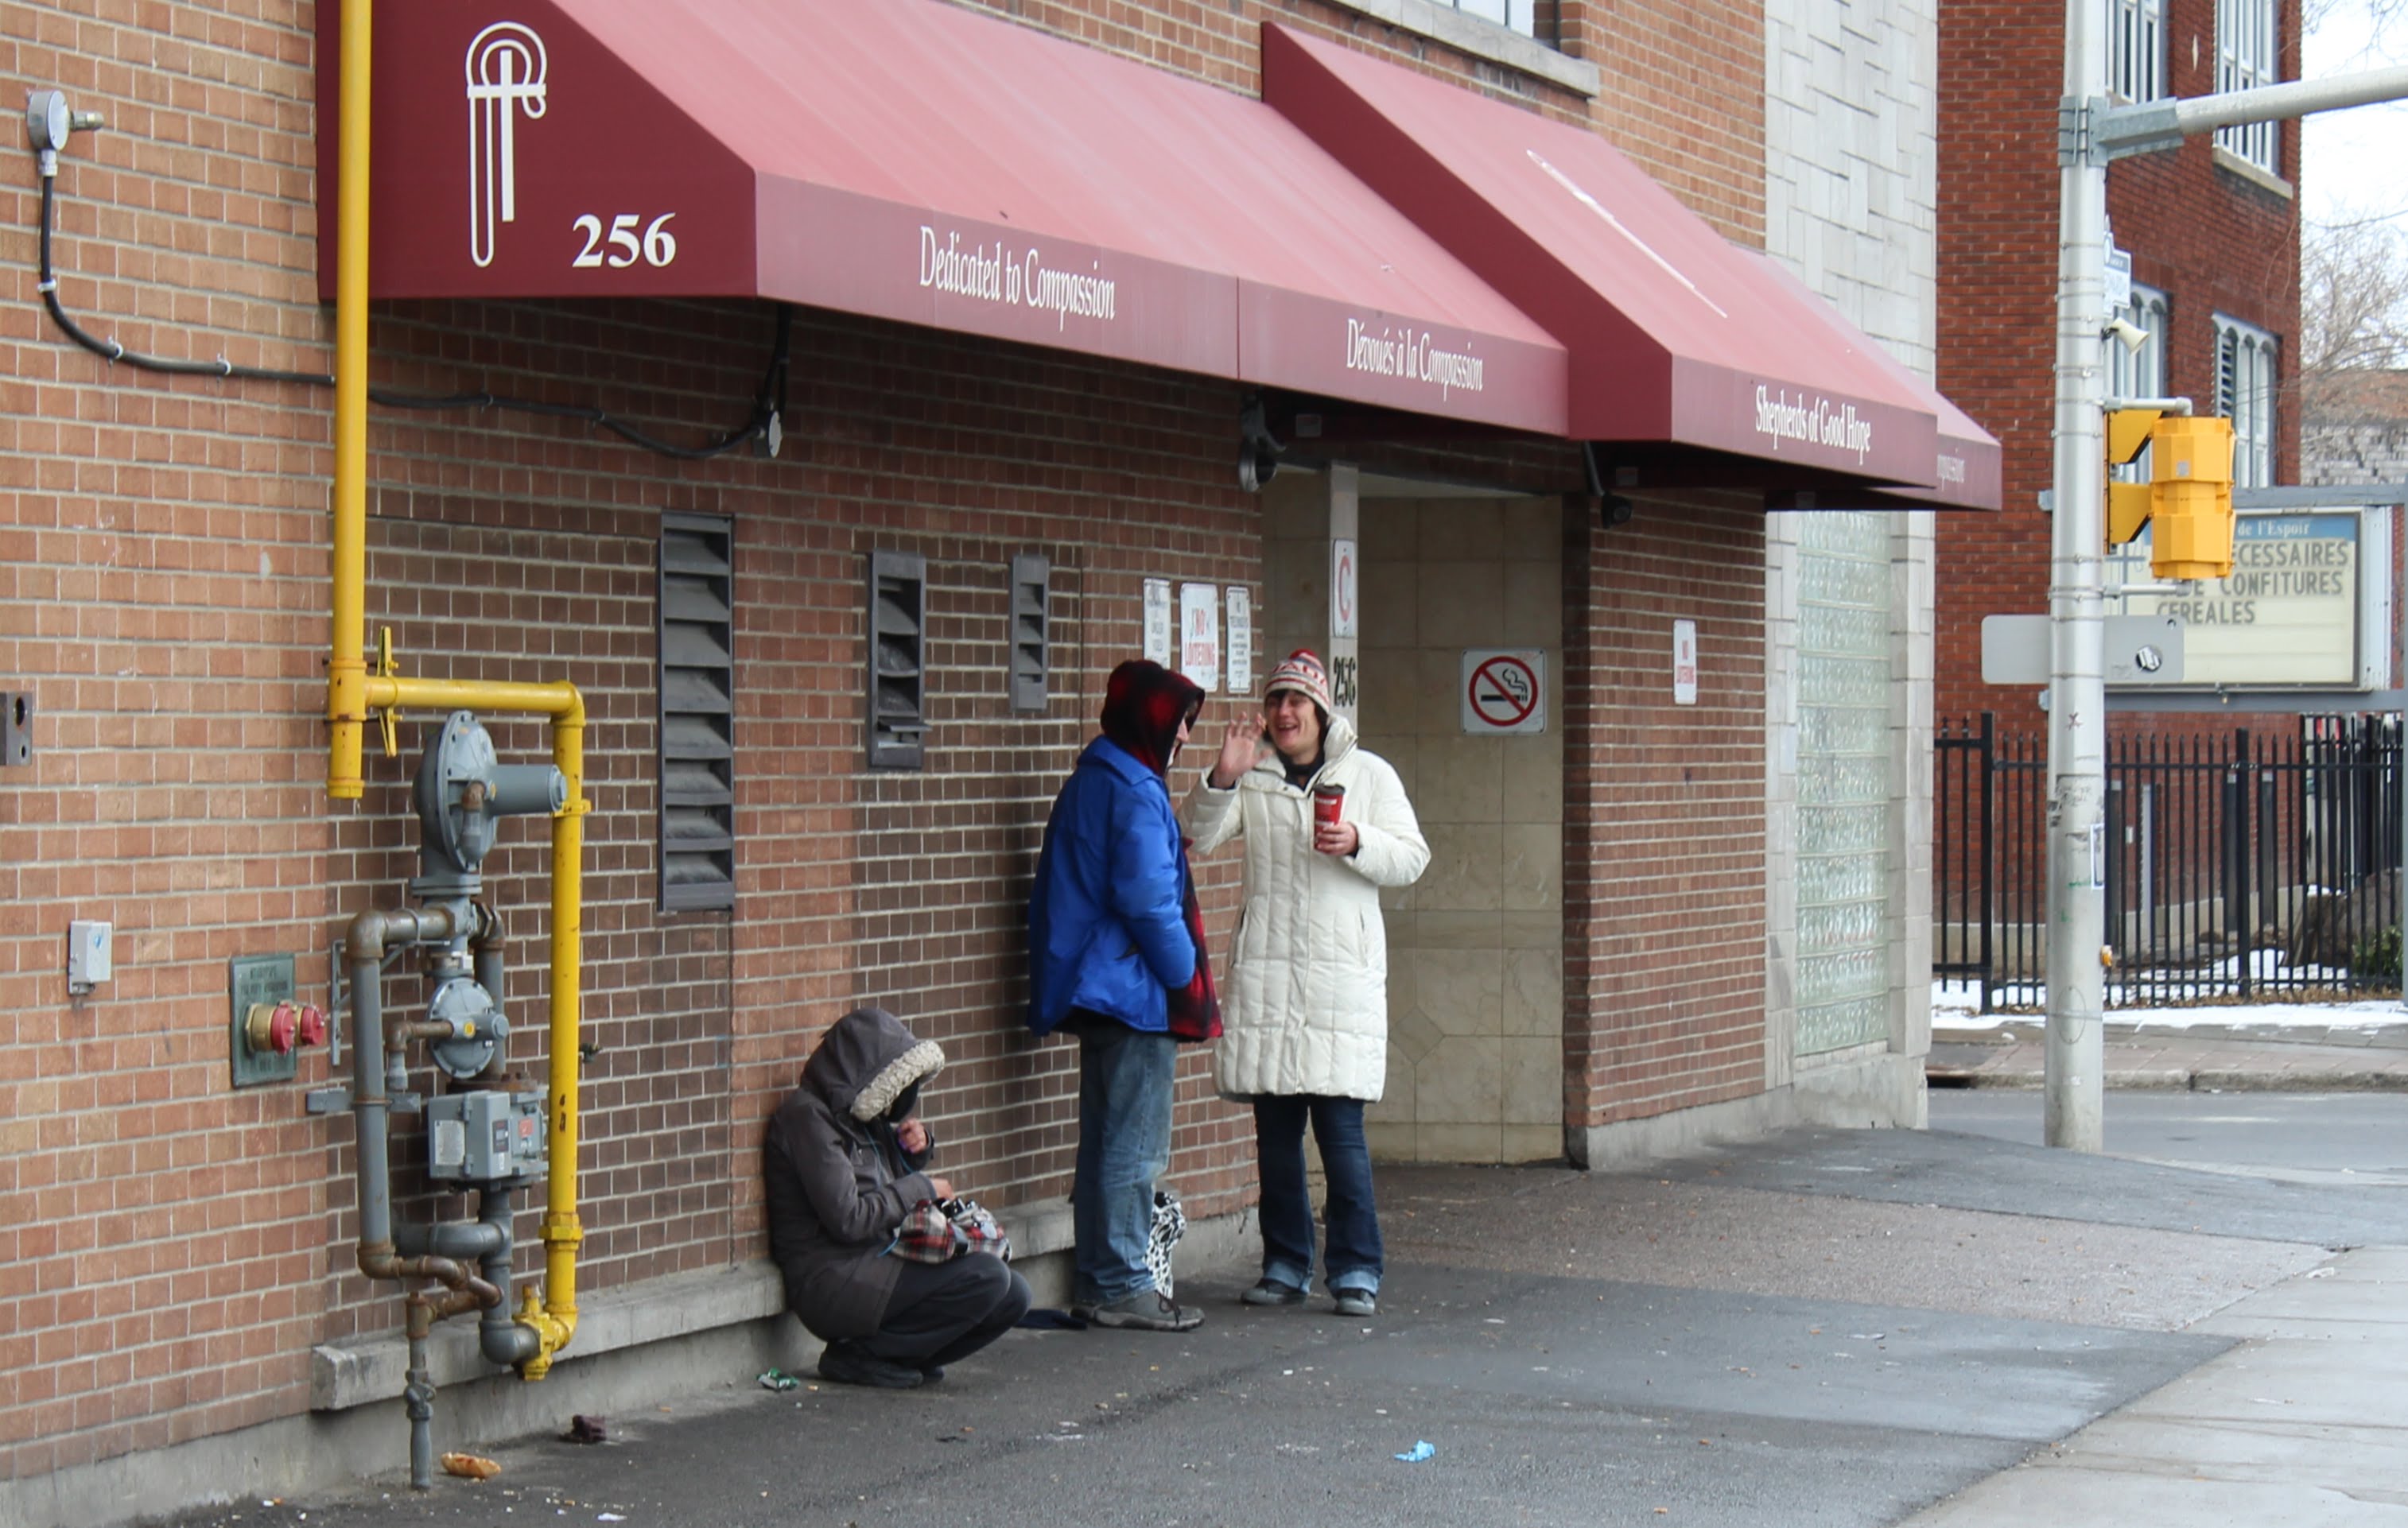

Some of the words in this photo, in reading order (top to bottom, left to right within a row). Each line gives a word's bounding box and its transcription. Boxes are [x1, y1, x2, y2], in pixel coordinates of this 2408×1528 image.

[572, 211, 676, 268] 256
[919, 225, 1001, 301] Dedicated
[1005, 250, 1021, 305] to
[1025, 247, 1116, 332] Compassion
[1346, 318, 1395, 376] Dévoués
[1396, 328, 1404, 378] à
[1406, 328, 1417, 379] la
[1420, 332, 1484, 401] Compassion
[1755, 384, 1808, 451] Shepherds
[1808, 396, 1820, 443] of
[1820, 399, 1845, 448] Good
[1847, 405, 1871, 466] Hope
[2232, 542, 2348, 567] CESSAIRES
[2238, 521, 2252, 537] de
[2257, 520, 2310, 538] l'Espoir
[2220, 571, 2343, 595] CONFITURES
